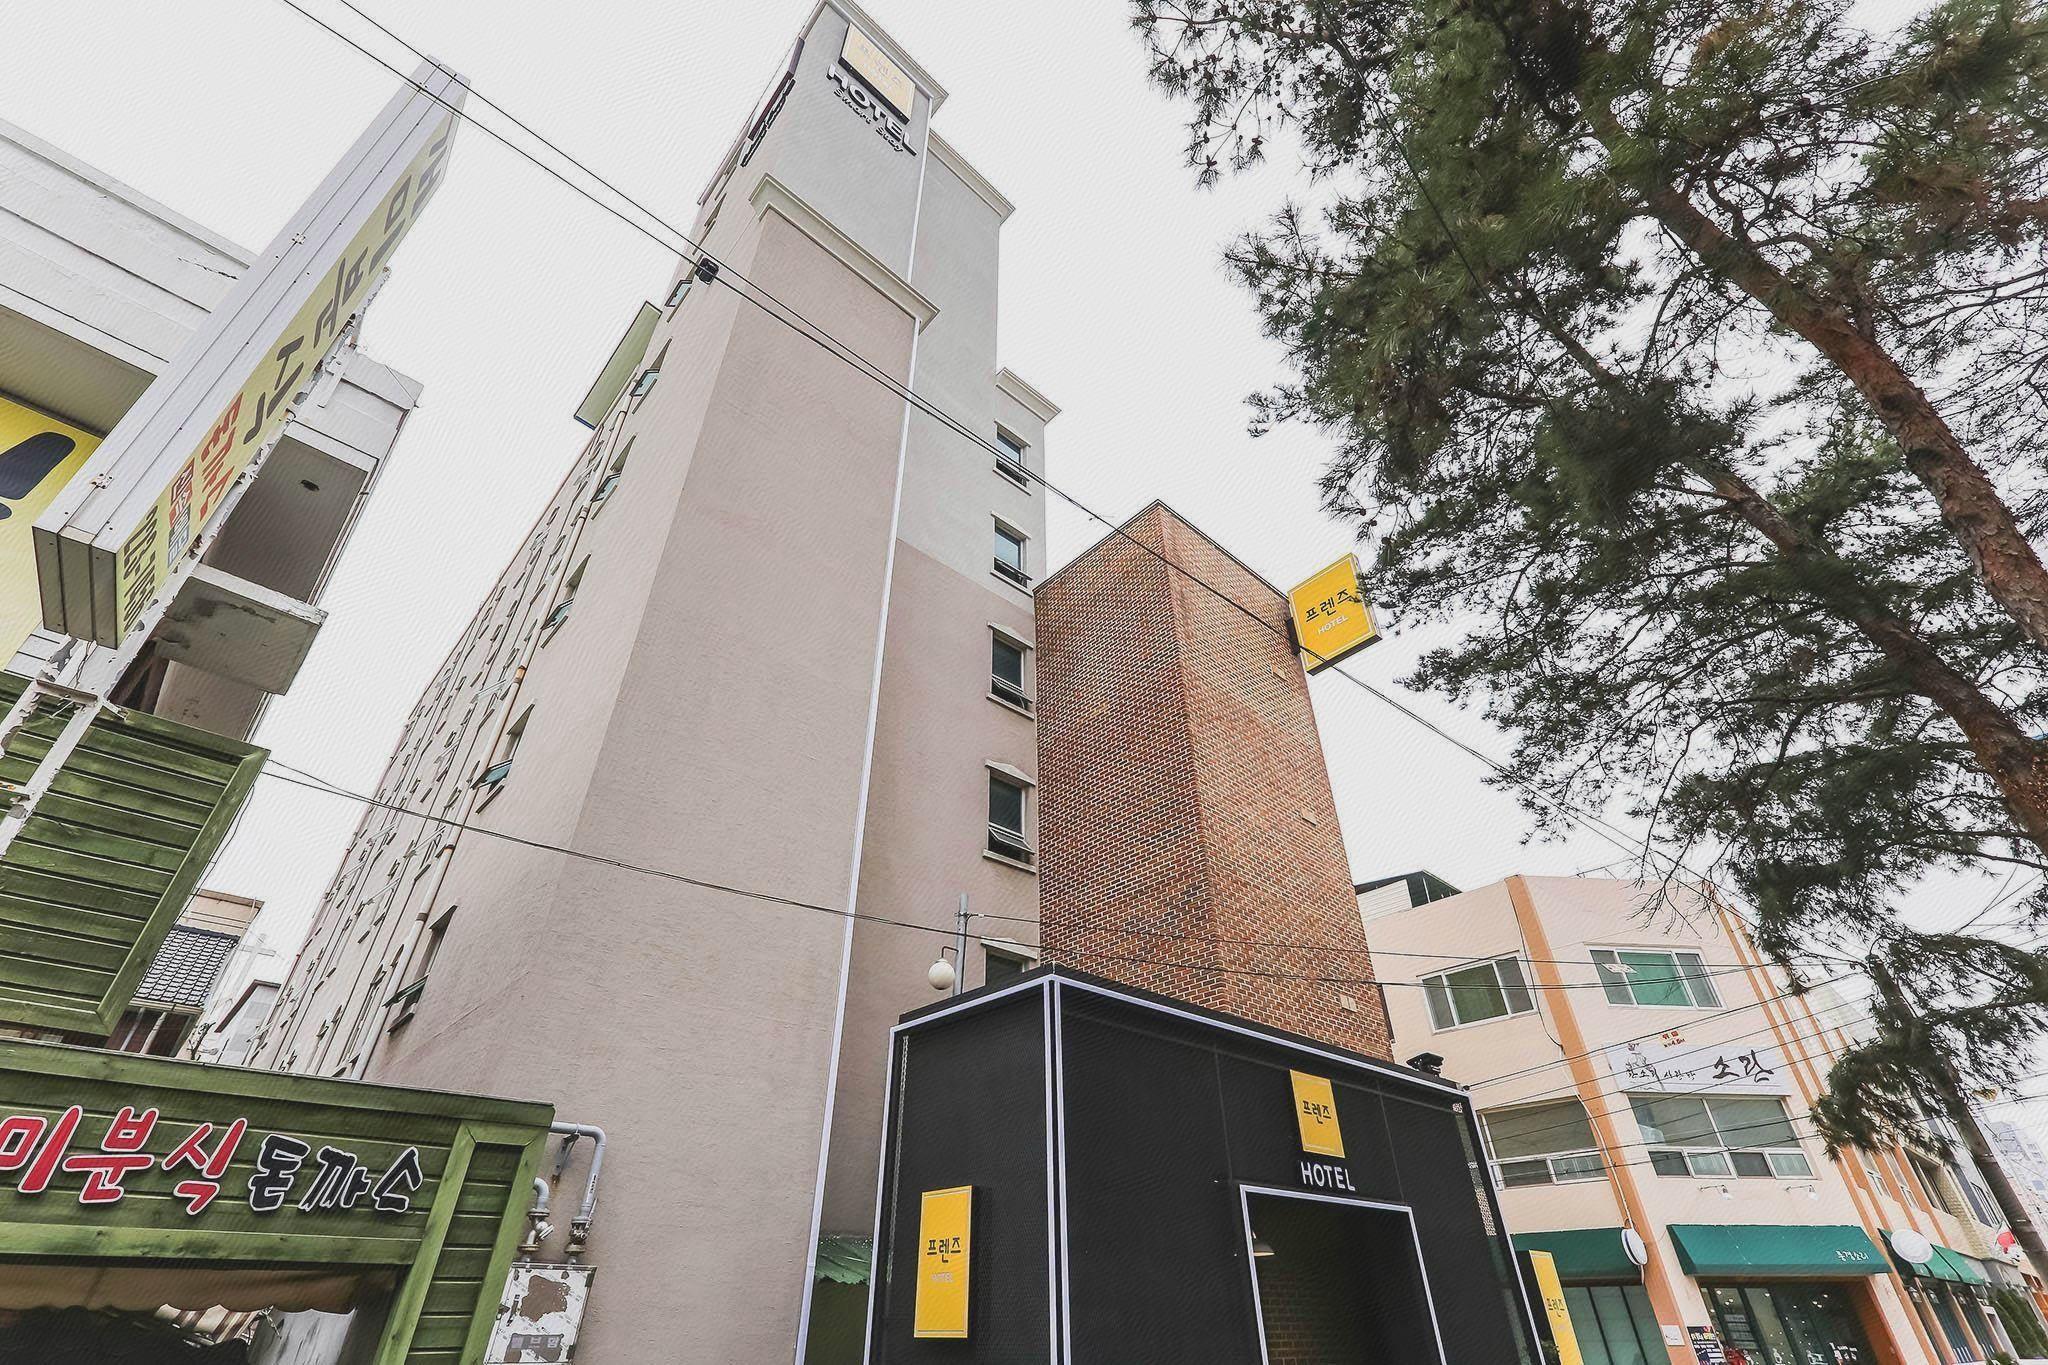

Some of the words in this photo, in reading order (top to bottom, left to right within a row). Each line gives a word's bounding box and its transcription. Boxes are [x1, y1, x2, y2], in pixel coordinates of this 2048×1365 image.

[826, 63, 918, 157] HOTEL
[124, 504, 158, 633] 223-7456
[1306, 588, 1351, 622] 프렌즈
[1318, 615, 1349, 635] HOTEL
[1302, 1100, 1332, 1124] 프렌즈
[248, 1133, 424, 1213] 돈까스
[1300, 1161, 1356, 1192] HOTEL
[926, 1237, 962, 1263] 프렌즈
